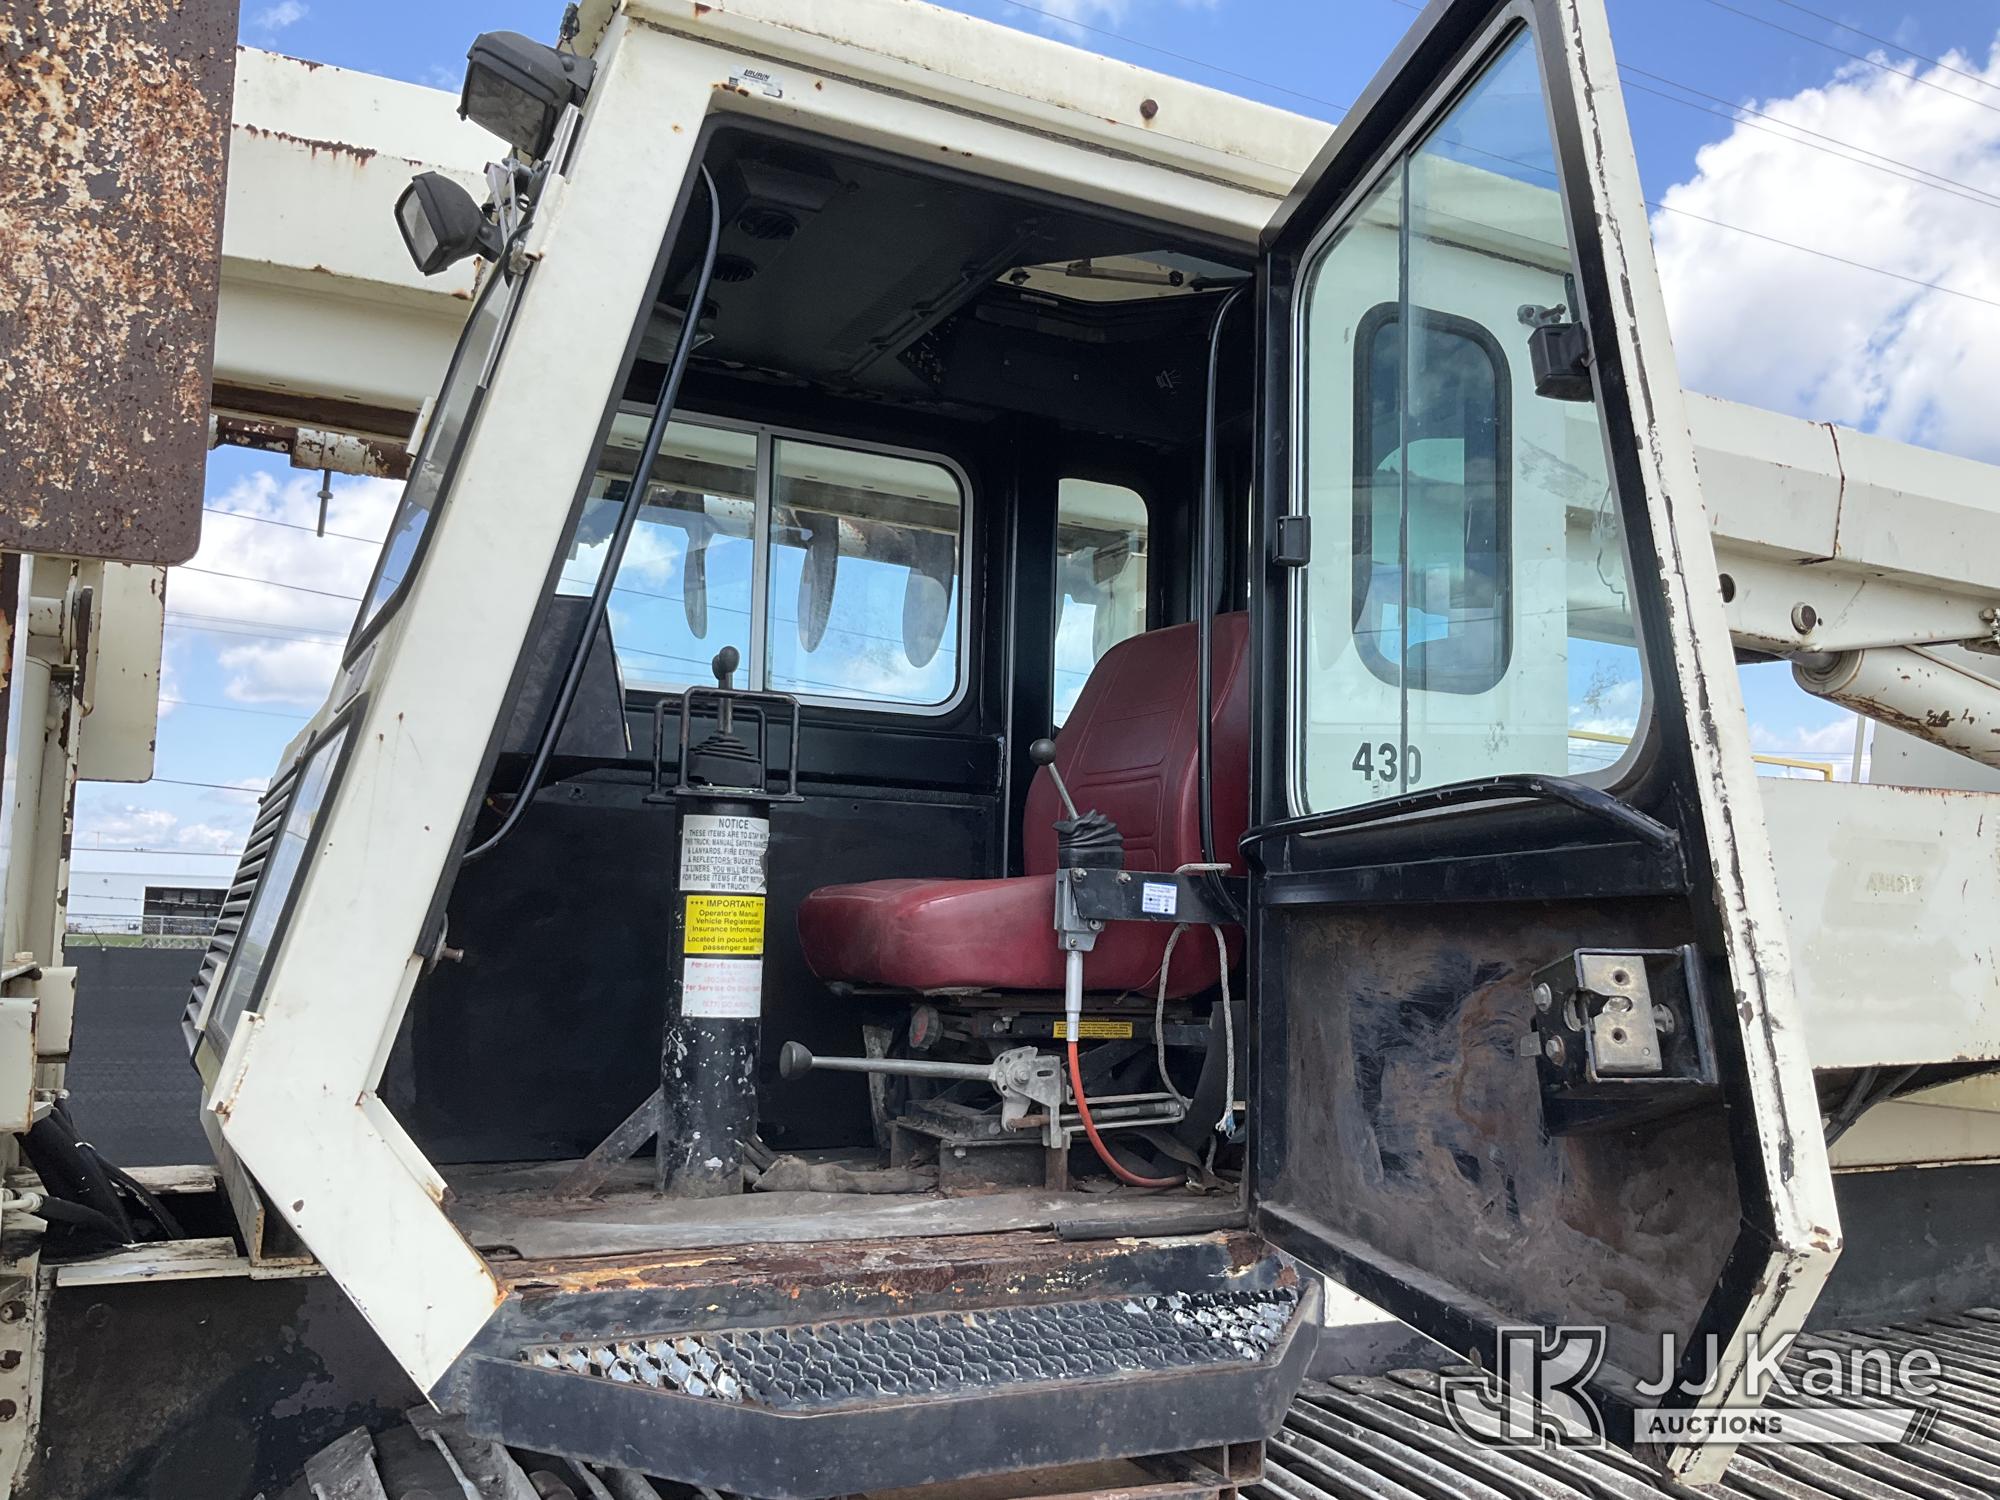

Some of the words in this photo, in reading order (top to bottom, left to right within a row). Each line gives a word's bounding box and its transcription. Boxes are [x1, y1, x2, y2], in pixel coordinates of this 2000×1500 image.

[1351, 742, 1422, 784] 430
[718, 818, 749, 829] NOTICE
[689, 829, 706, 837] THESE
[707, 830, 726, 838] ITEMS
[733, 857, 754, 865] BUCKET
[713, 865, 725, 873] YOU
[726, 866, 740, 874] WILL
[741, 867, 748, 875] BE
[692, 873, 710, 881] THESE
[711, 874, 730, 882] ITEMS
[706, 900, 755, 908] IMPORTANT
[699, 909, 737, 918] Operator's
[726, 937, 748, 945] pouch
[702, 944, 742, 953] passenger
